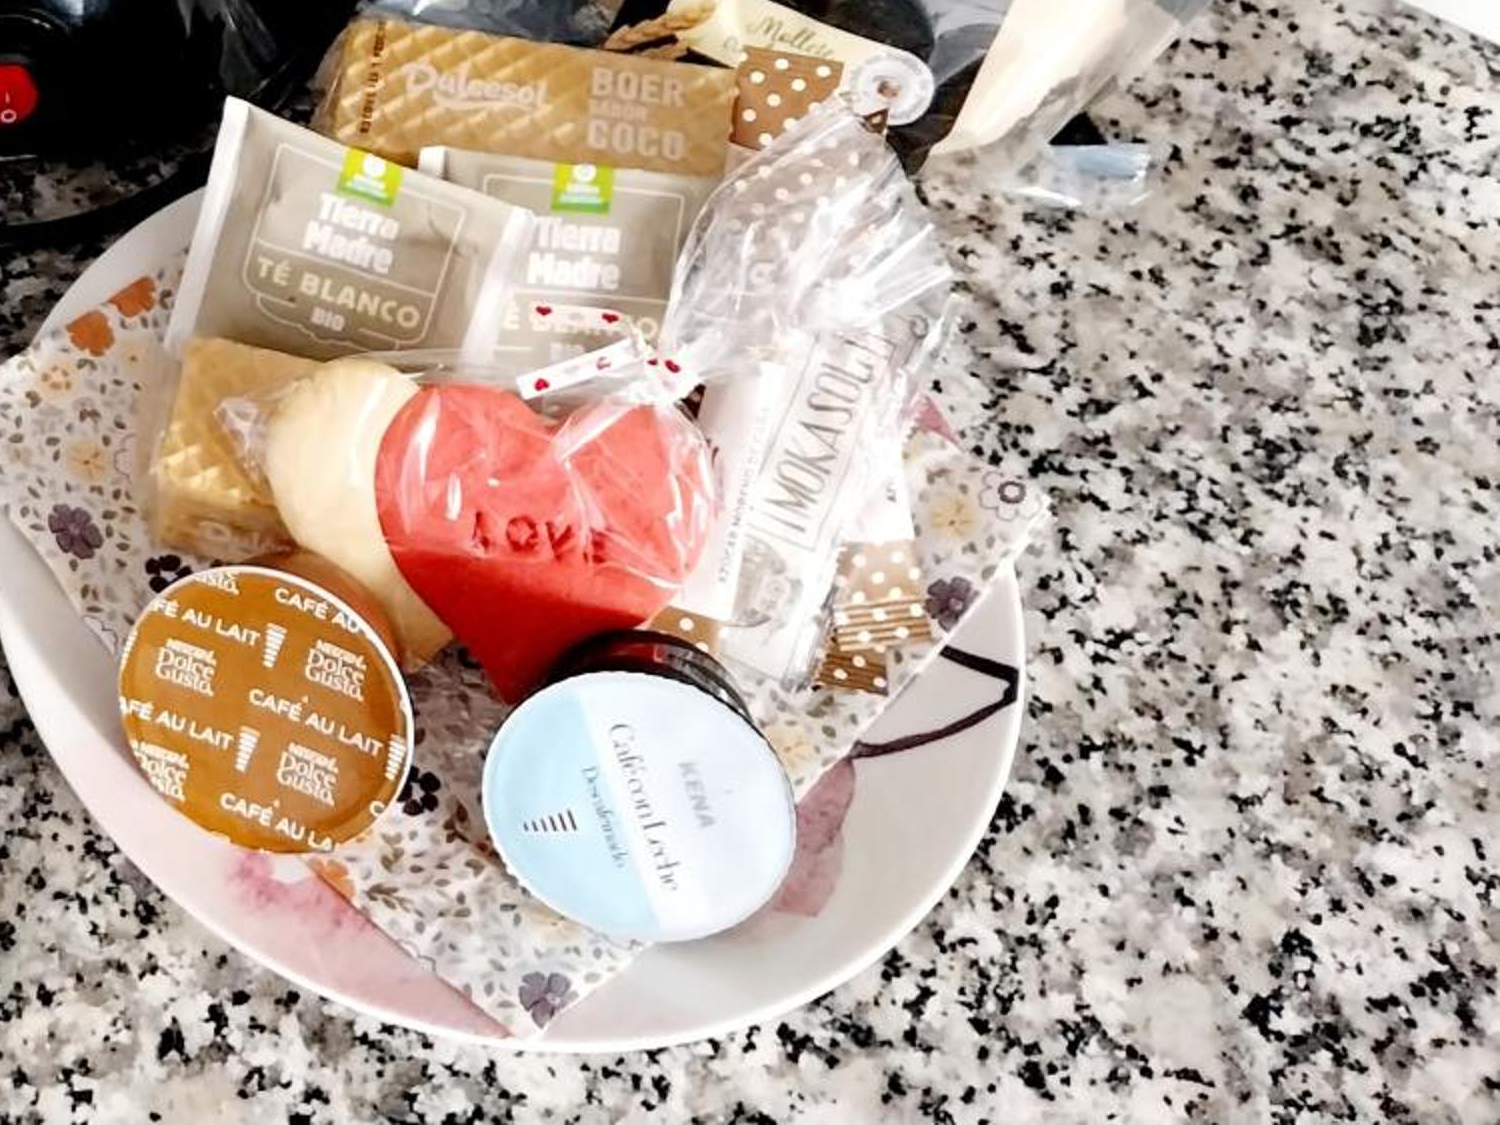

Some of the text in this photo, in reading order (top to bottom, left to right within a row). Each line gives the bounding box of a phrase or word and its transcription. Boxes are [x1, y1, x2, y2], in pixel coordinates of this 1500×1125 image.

[586, 119, 686, 161] COCO
[317, 191, 400, 241] Tierra
[531, 216, 621, 255] Tierra
[301, 219, 394, 275] Madre
[526, 251, 621, 291] Madre
[256, 255, 421, 328] TÉ BLANCO
[181, 607, 213, 629] AU
[215, 618, 261, 647] LAIT
[275, 587, 329, 620] CAFÉ
[118, 695, 235, 752] AFÉ AU LAIT
[248, 688, 384, 758] CAFÉ AU LAIT
[220, 791, 274, 827] CAFÉ
[275, 817, 306, 841] AU
[678, 760, 717, 829] KENA
